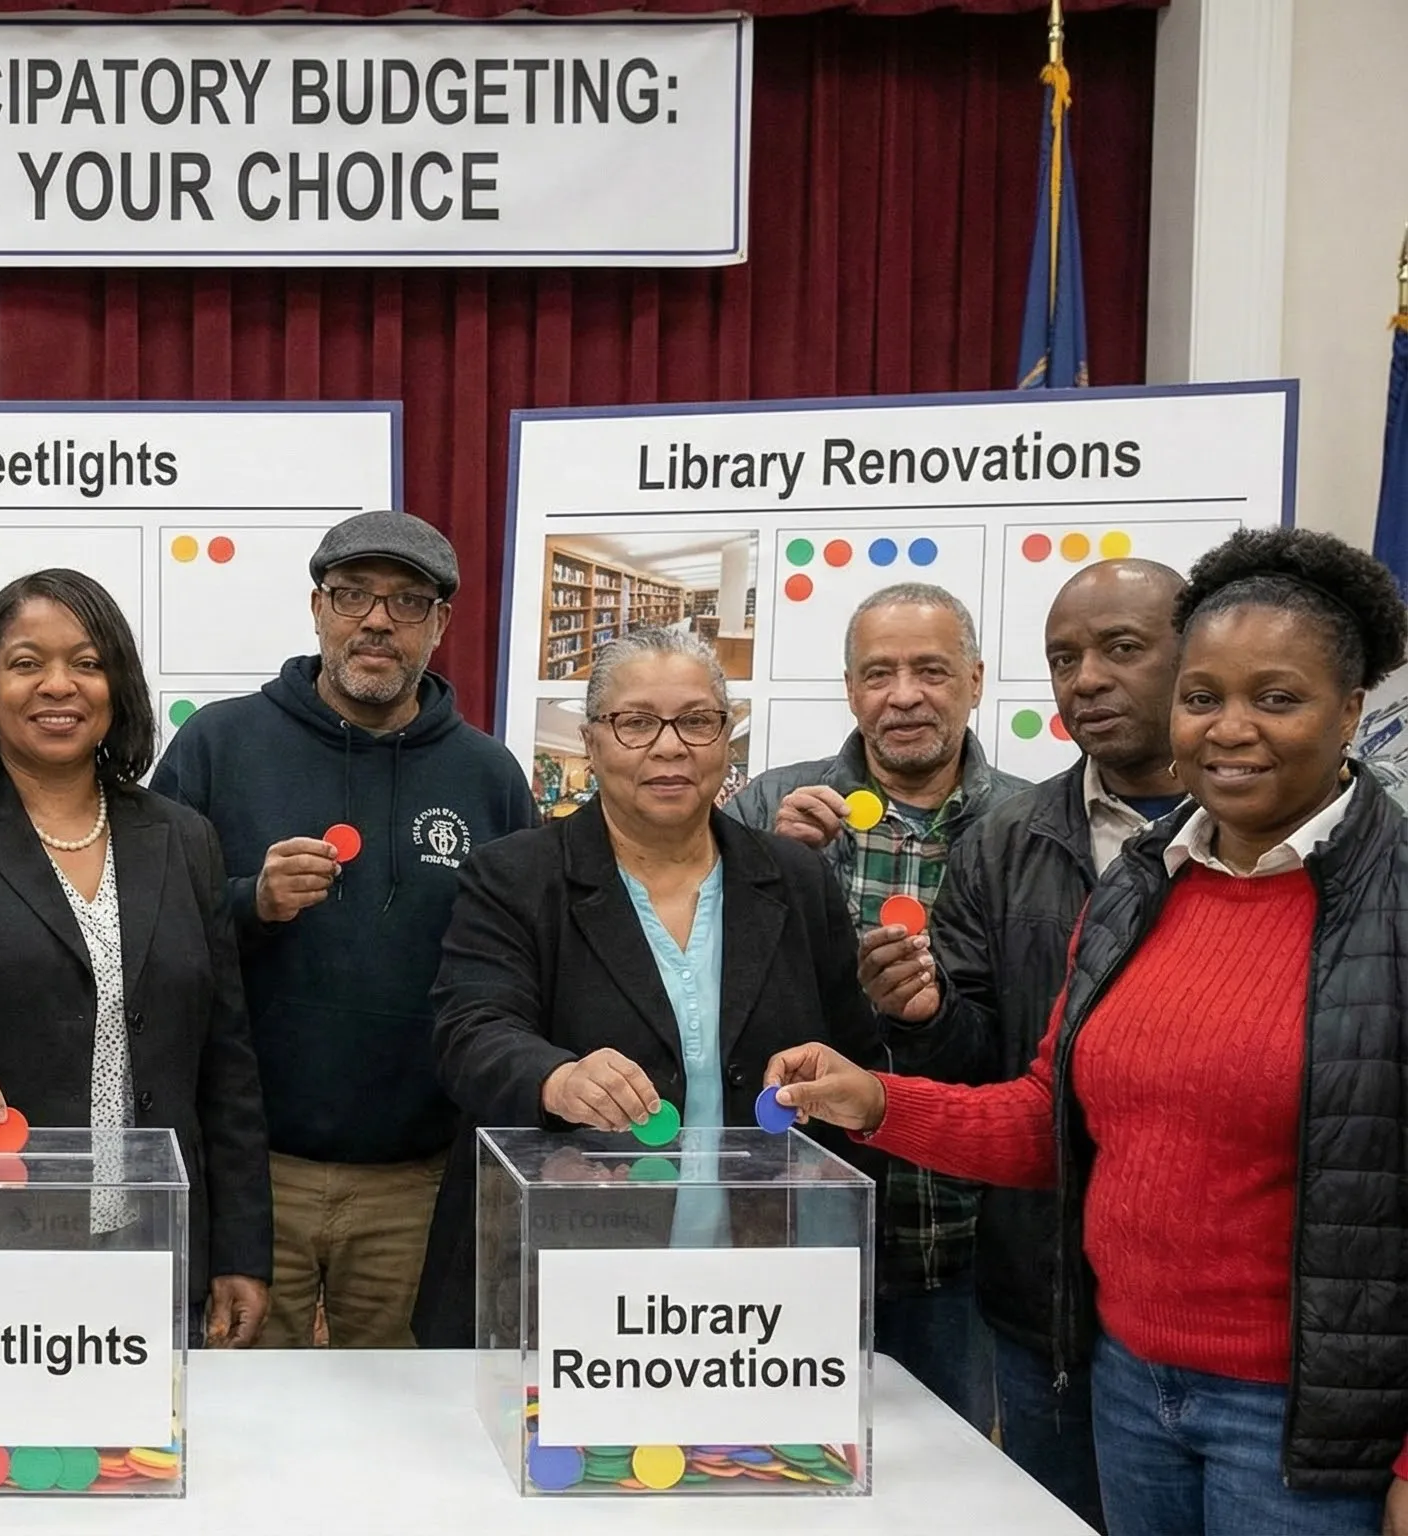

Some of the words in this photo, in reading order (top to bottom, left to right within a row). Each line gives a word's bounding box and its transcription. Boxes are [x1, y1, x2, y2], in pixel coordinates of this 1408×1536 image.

[292, 57, 679, 126] BUDGETING:
[17, 150, 214, 222] YOUR
[237, 150, 500, 222] CHOICE
[639, 443, 805, 500] Library
[822, 431, 1142, 486] Renovations
[617, 1294, 783, 1345] Library
[553, 1347, 846, 1389] Renovations
